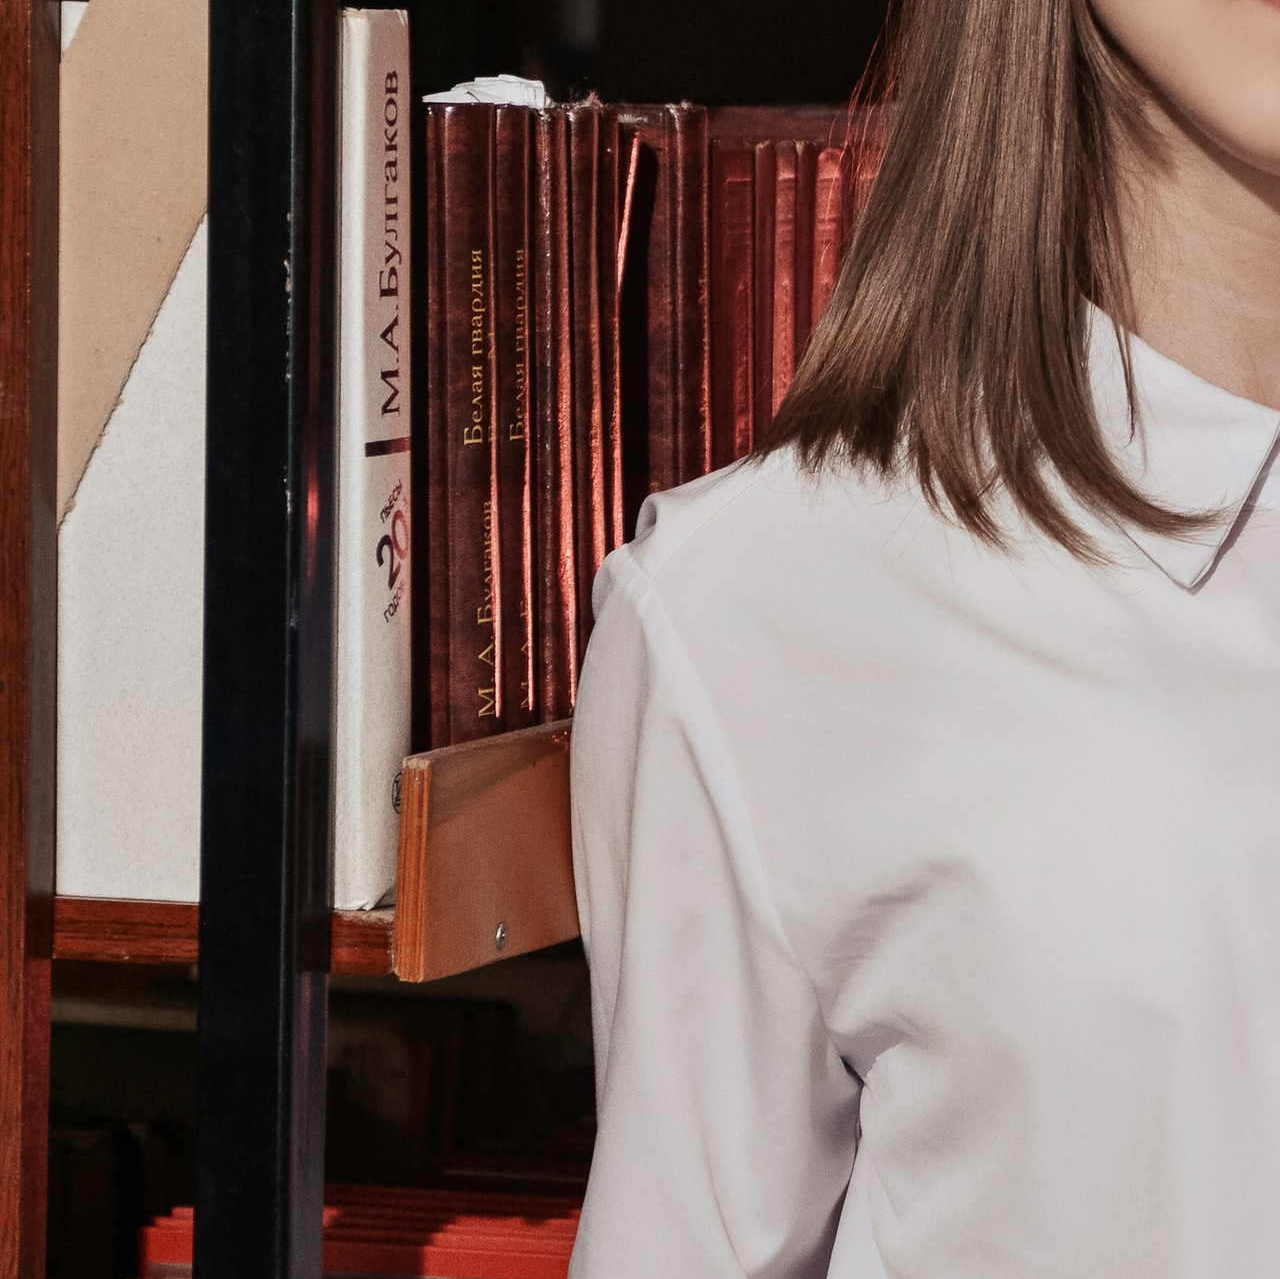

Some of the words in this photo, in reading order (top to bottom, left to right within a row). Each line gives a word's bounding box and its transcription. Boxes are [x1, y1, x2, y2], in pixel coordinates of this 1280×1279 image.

[471, 249, 486, 355] гвардия
[514, 249, 527, 353] гвардия
[463, 365, 483, 445] Белая
[508, 363, 525, 442] Белая
